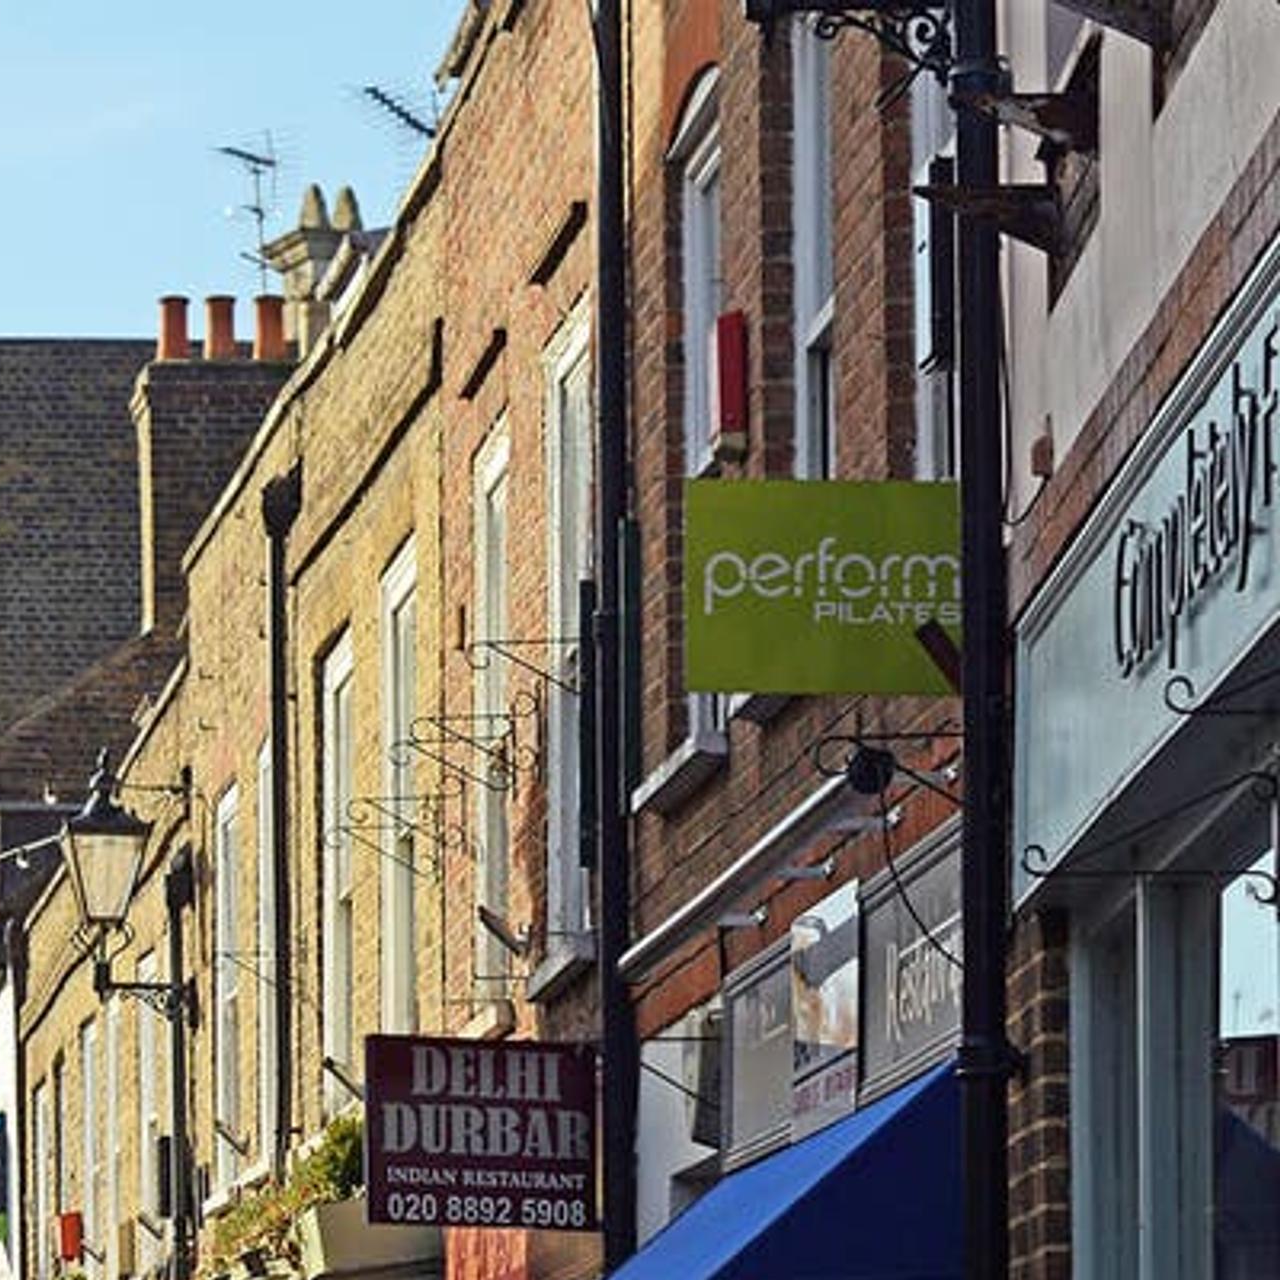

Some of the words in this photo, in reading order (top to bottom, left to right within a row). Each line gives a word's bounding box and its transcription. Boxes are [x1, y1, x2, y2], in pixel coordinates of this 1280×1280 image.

[703, 536, 962, 616] perform
[814, 601, 963, 625] PILATES
[410, 1046, 562, 1101] DELHI
[382, 1104, 589, 1160] DURBAR
[387, 1166, 457, 1186] INDIAN
[462, 1169, 585, 1190] RESTAURANT
[387, 1193, 437, 1221] 020
[445, 1196, 511, 1224] 8892
[521, 1199, 585, 1227] 5908
